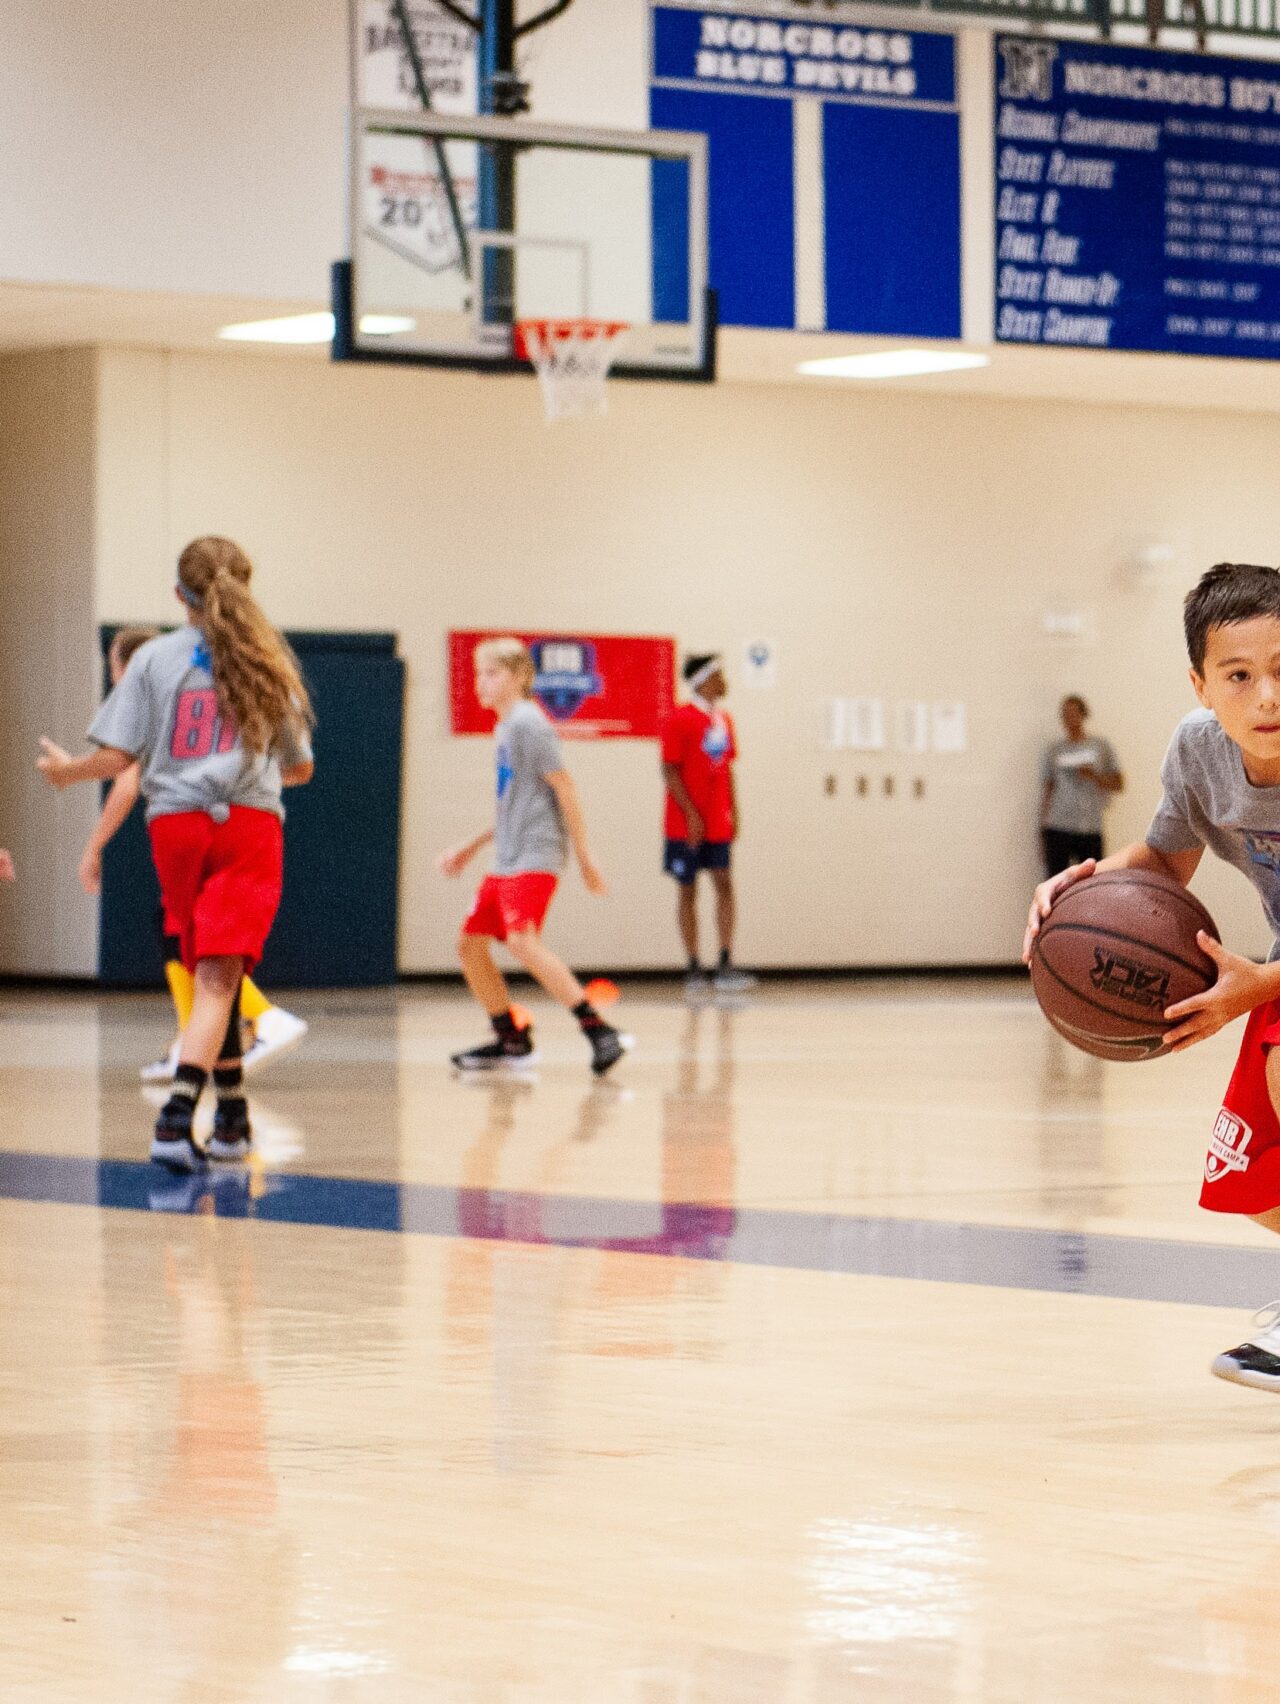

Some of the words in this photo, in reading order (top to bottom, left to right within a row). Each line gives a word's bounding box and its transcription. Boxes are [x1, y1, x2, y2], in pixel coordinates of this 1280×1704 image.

[701, 16, 913, 63] NORCROSS
[696, 50, 786, 83] BLUE
[794, 60, 917, 95] DEVILS
[1064, 60, 1225, 109] NORCROSS
